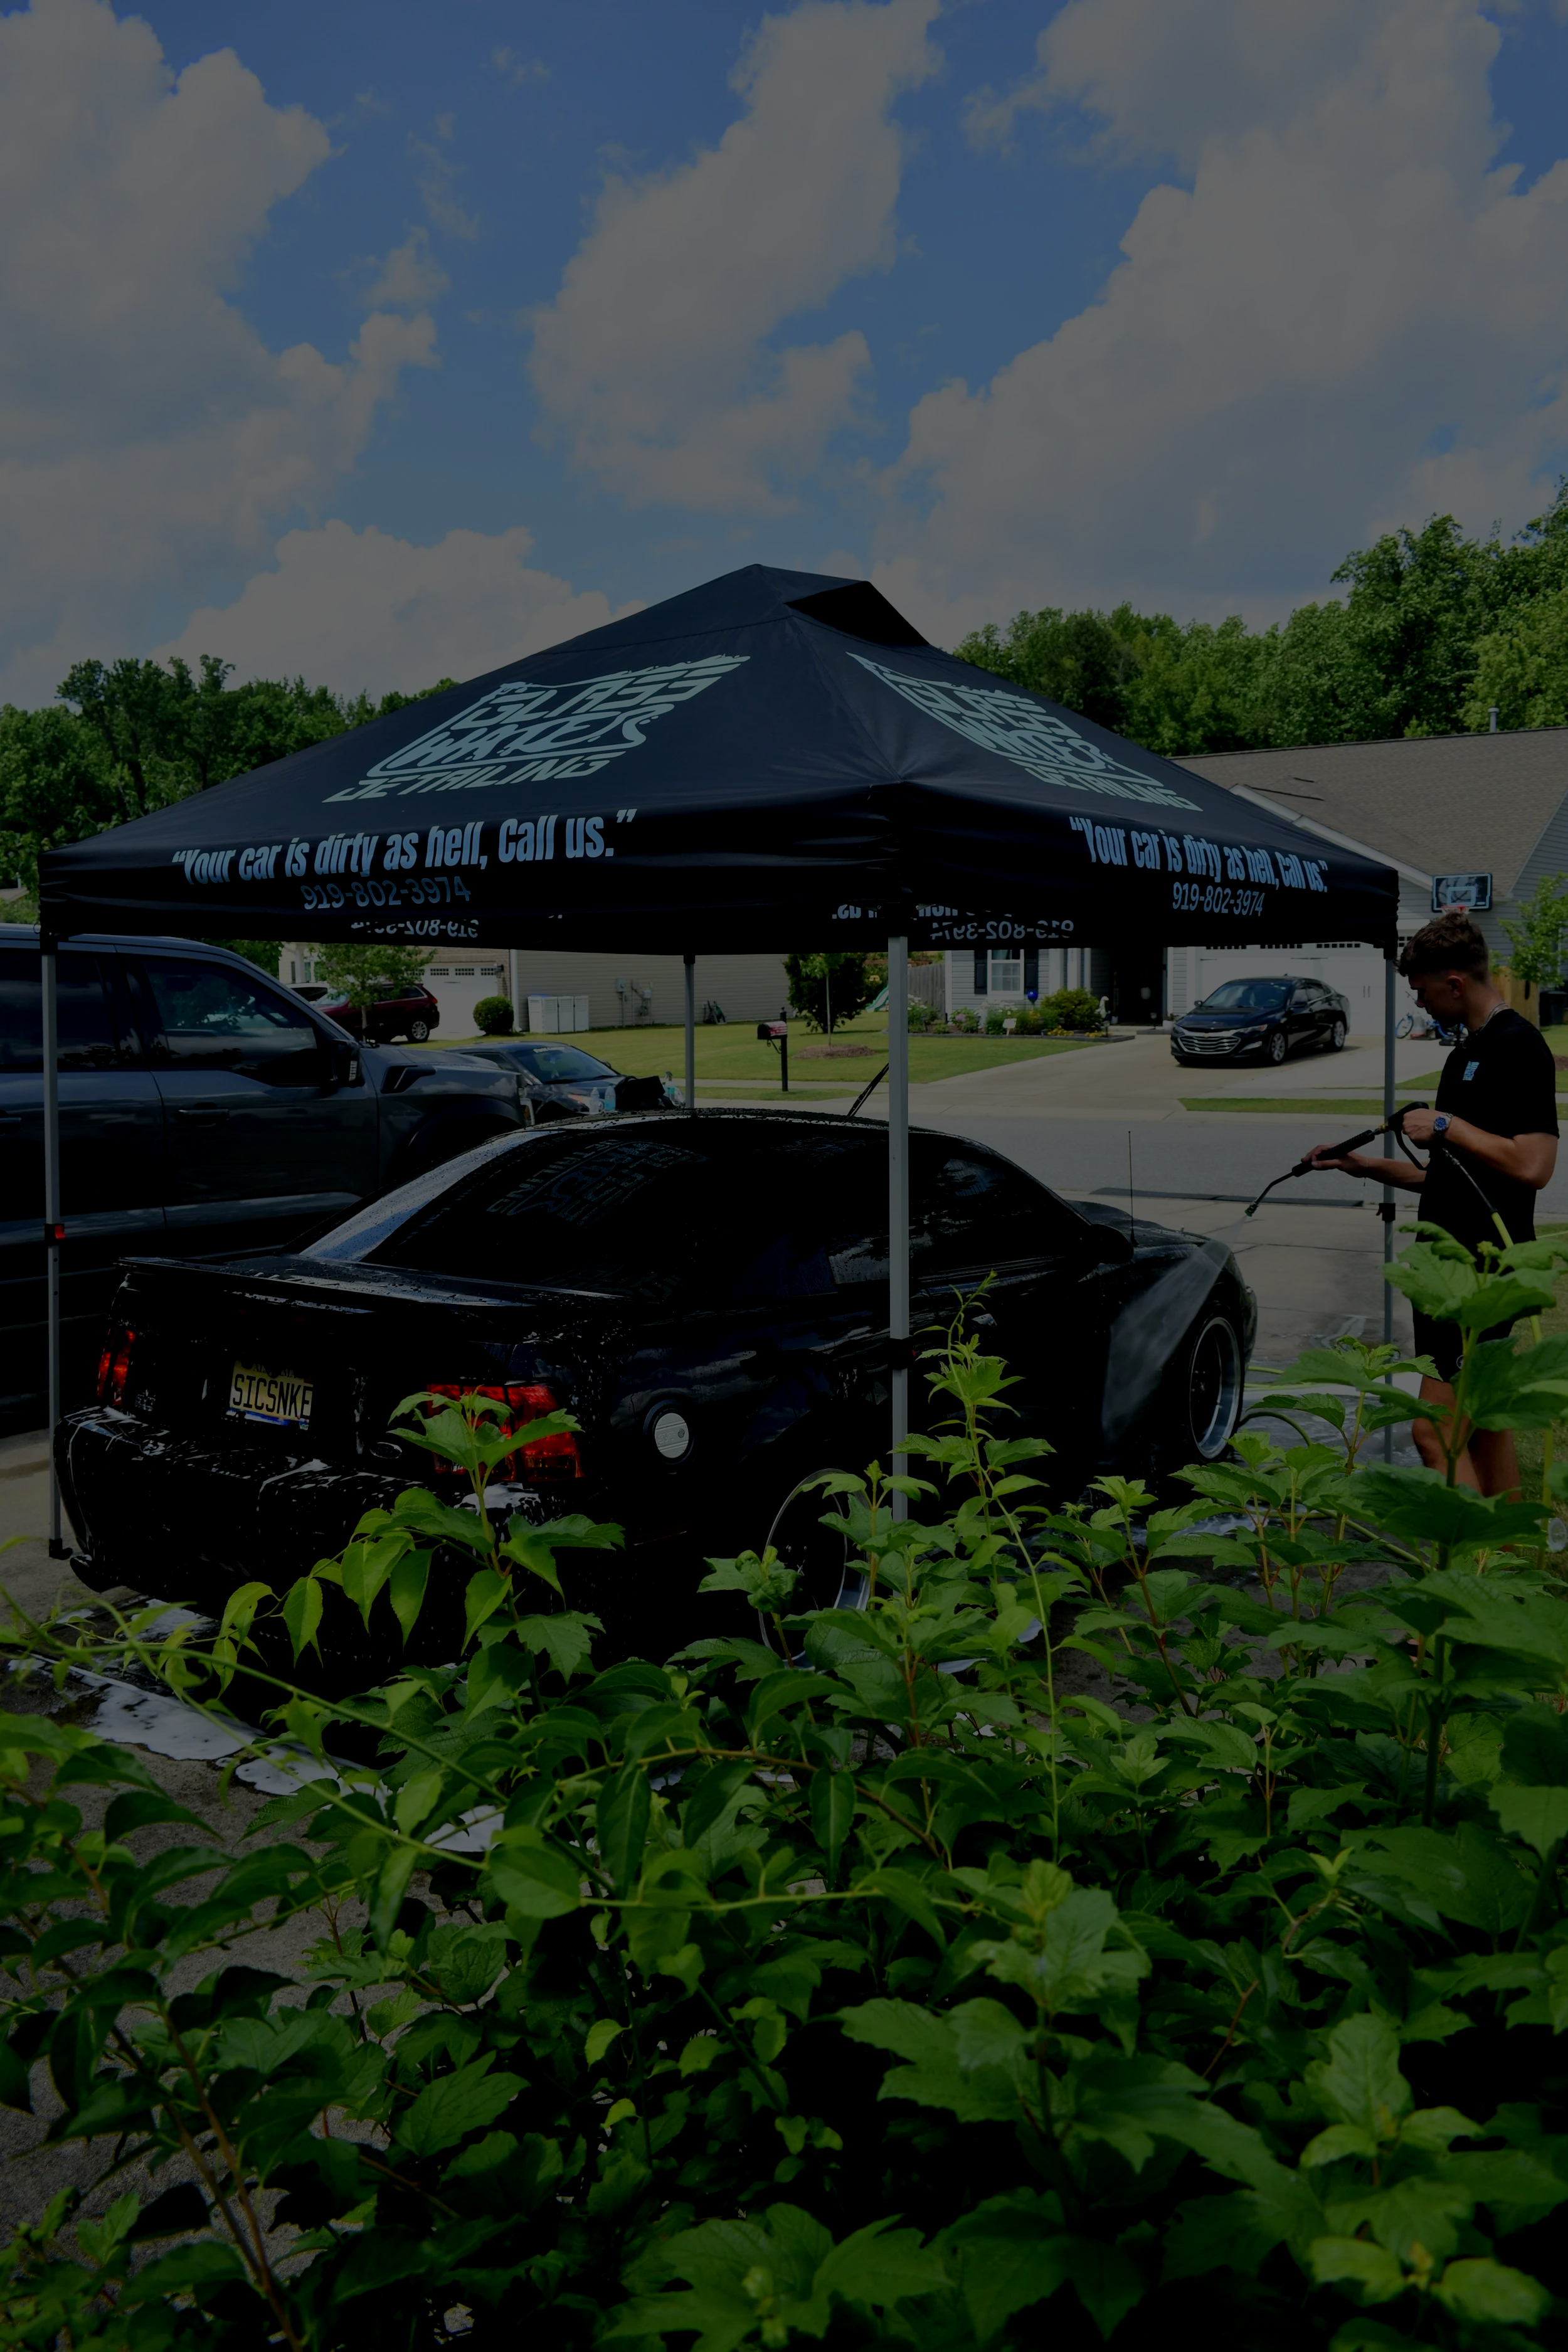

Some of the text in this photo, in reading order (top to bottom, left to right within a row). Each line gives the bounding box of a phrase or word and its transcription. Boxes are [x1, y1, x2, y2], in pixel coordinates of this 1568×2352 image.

[450, 663, 742, 731] GLASS
[882, 672, 1083, 739] GLASS
[322, 751, 626, 803] DETAILING
[1008, 758, 1204, 812] DETAILING
[238, 844, 282, 881] car
[284, 837, 309, 877] is
[313, 832, 379, 877] dirty
[383, 832, 419, 871] as
[425, 822, 488, 870] hell,
[498, 814, 558, 864] Call
[1131, 830, 1161, 870] car
[1158, 829, 1182, 872] is
[1183, 834, 1222, 883] dirty
[1223, 845, 1246, 881] as
[1240, 845, 1279, 890] hell,
[300, 875, 472, 910] 919-802-3974
[1172, 881, 1266, 916] 919-802-3974
[232, 1374, 314, 1419] SICSNKE
